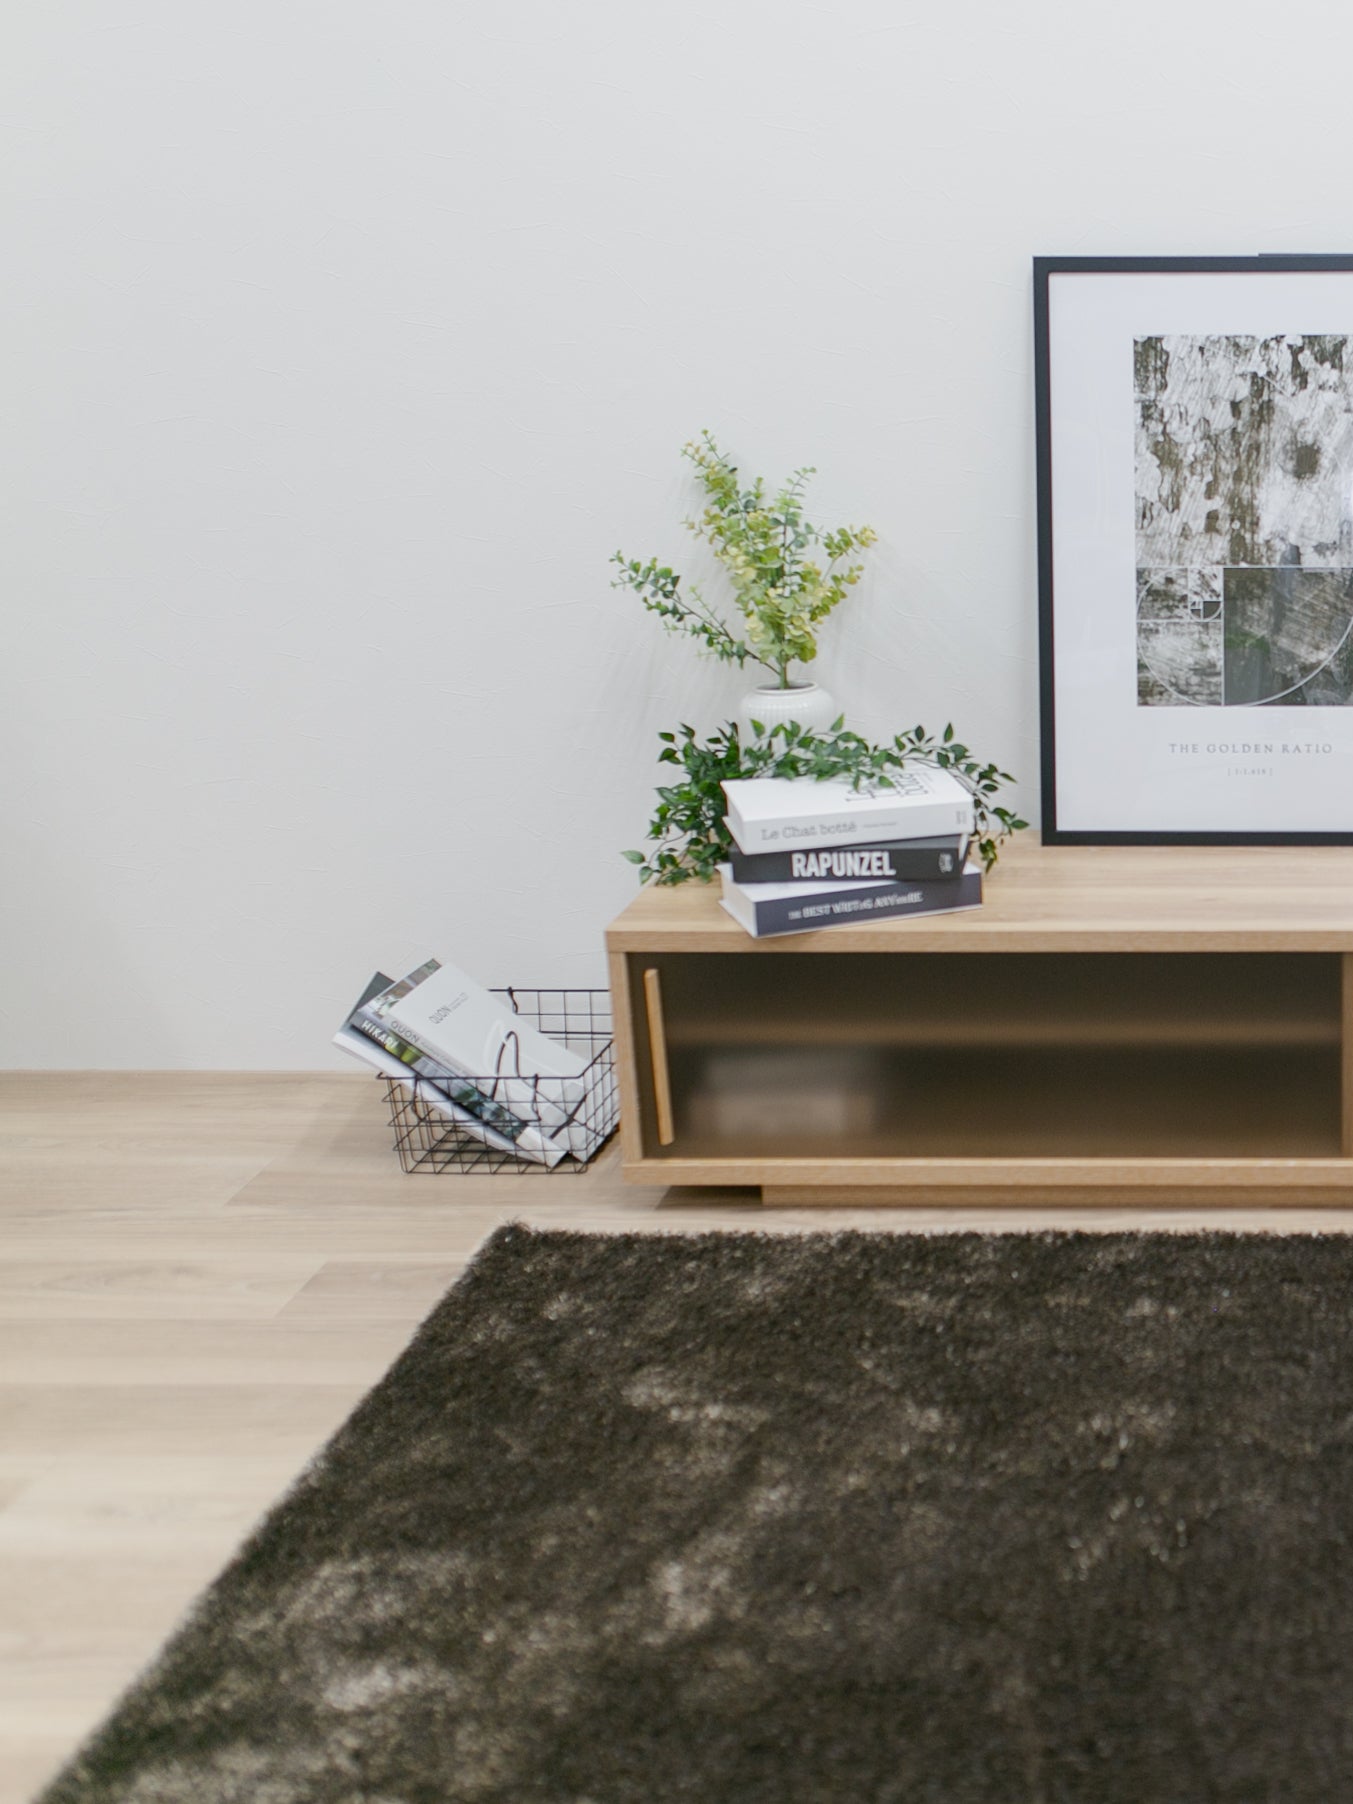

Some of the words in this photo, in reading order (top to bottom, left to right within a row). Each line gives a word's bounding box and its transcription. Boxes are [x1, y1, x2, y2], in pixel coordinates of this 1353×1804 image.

[1169, 743, 1200, 754] THE
[1206, 743, 1274, 754] GOLDEN
[1281, 743, 1333, 754] RATIO
[791, 851, 897, 878] RAPUNZEL
[802, 903, 831, 918] BEST
[361, 1019, 400, 1049] HIKARI
